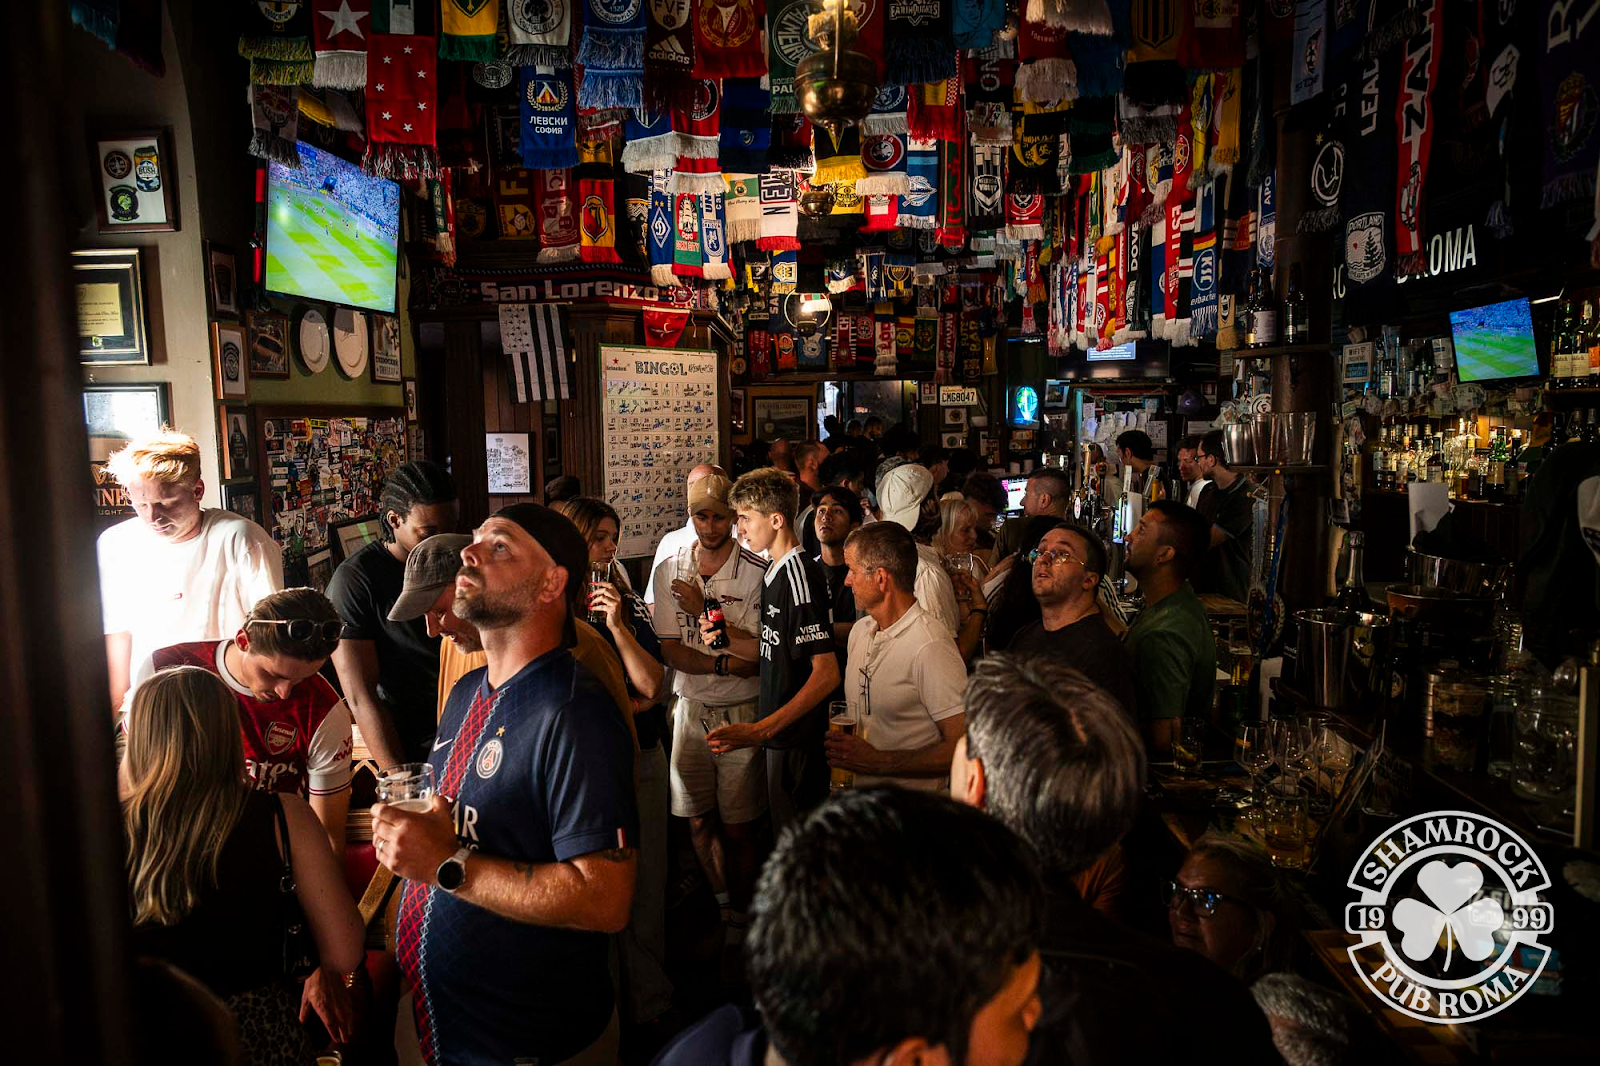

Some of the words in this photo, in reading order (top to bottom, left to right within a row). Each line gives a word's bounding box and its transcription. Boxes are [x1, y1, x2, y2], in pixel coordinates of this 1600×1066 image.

[648, 51, 691, 65] adidas
[529, 115, 568, 126] ЛЕВСКИ
[535, 126, 563, 135] СОФИЯ
[480, 282, 537, 302] San
[544, 279, 660, 302] Lorenzo
[800, 623, 821, 635] VISIT
[795, 631, 830, 645] RWANDA
[272, 726, 294, 736] Arsenal
